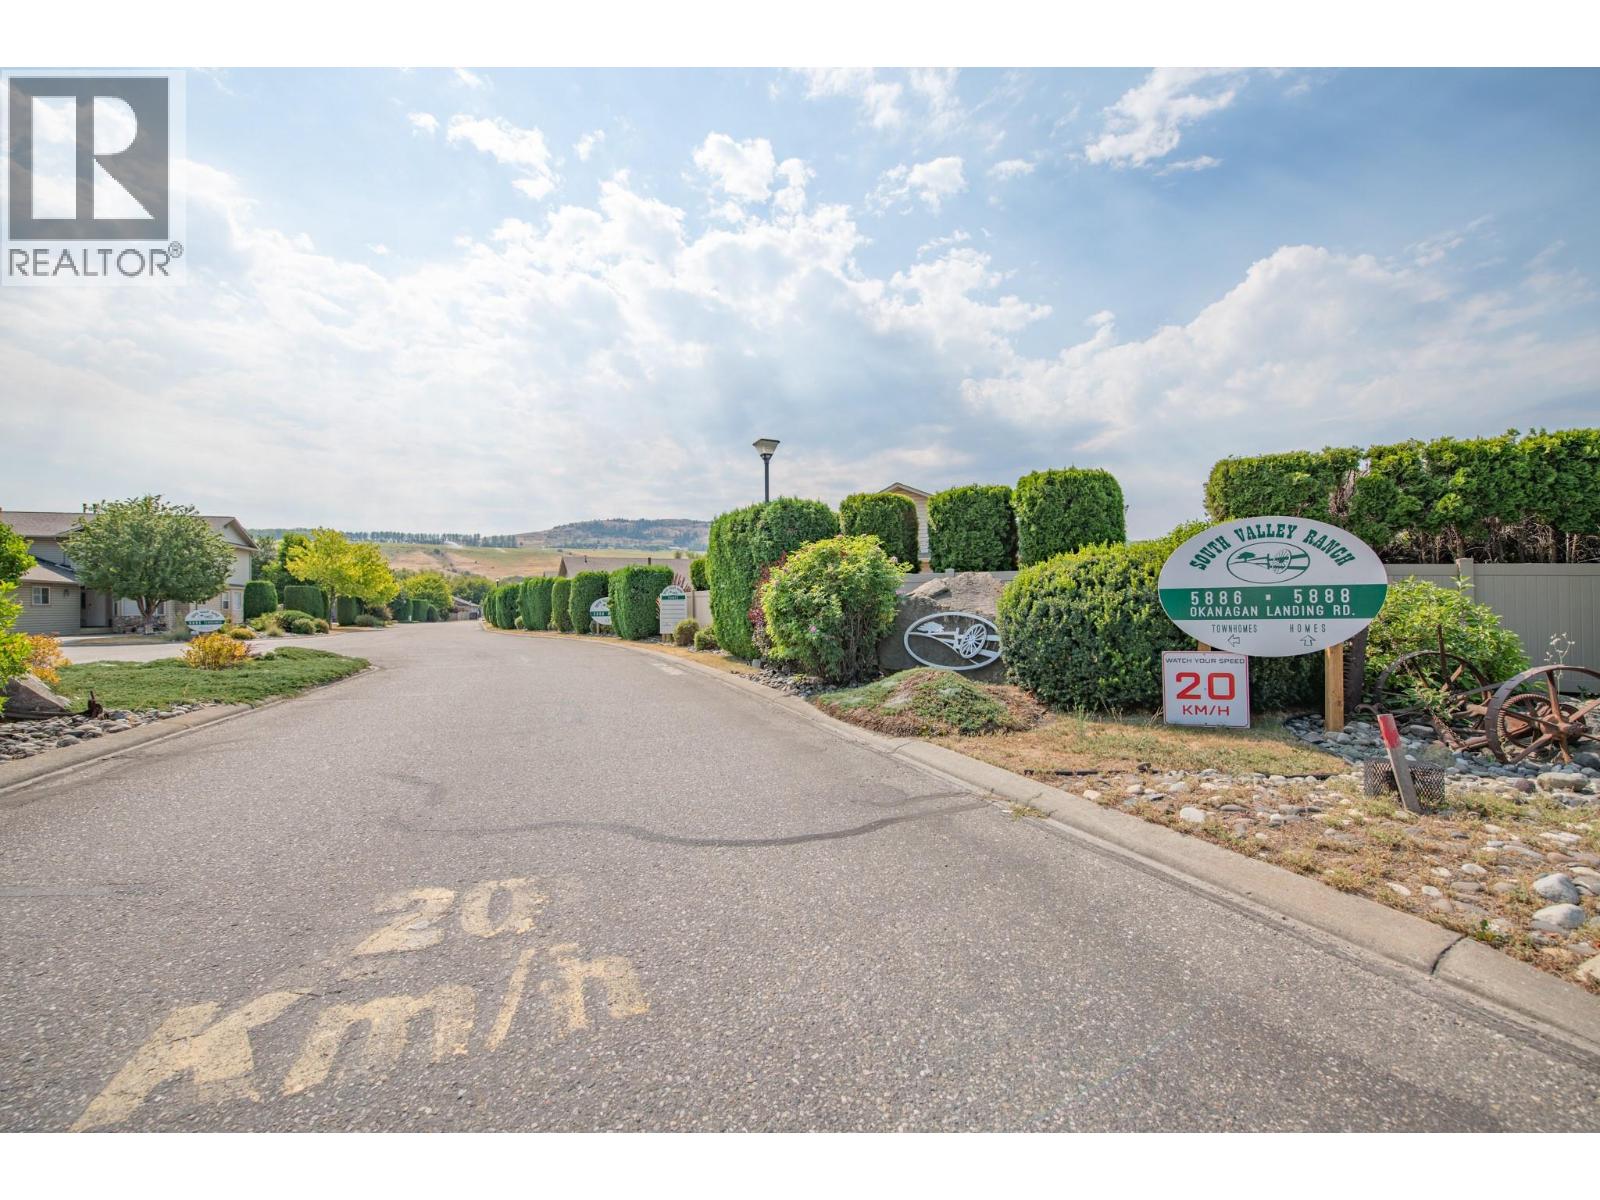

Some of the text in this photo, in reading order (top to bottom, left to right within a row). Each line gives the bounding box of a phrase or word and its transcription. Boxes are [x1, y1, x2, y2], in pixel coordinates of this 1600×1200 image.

[1189, 523, 1356, 571] SOUTH VALLEY RANCH
[1190, 588, 1350, 605] 5886 5888
[1189, 604, 1356, 617] OKANAGAN LANDING RD.
[1211, 624, 1258, 633] TOWNHOMES
[1289, 623, 1326, 633] HOMES
[1175, 672, 1236, 700] 20
[1182, 704, 1230, 716] KM/H
[350, 876, 553, 957] 20
